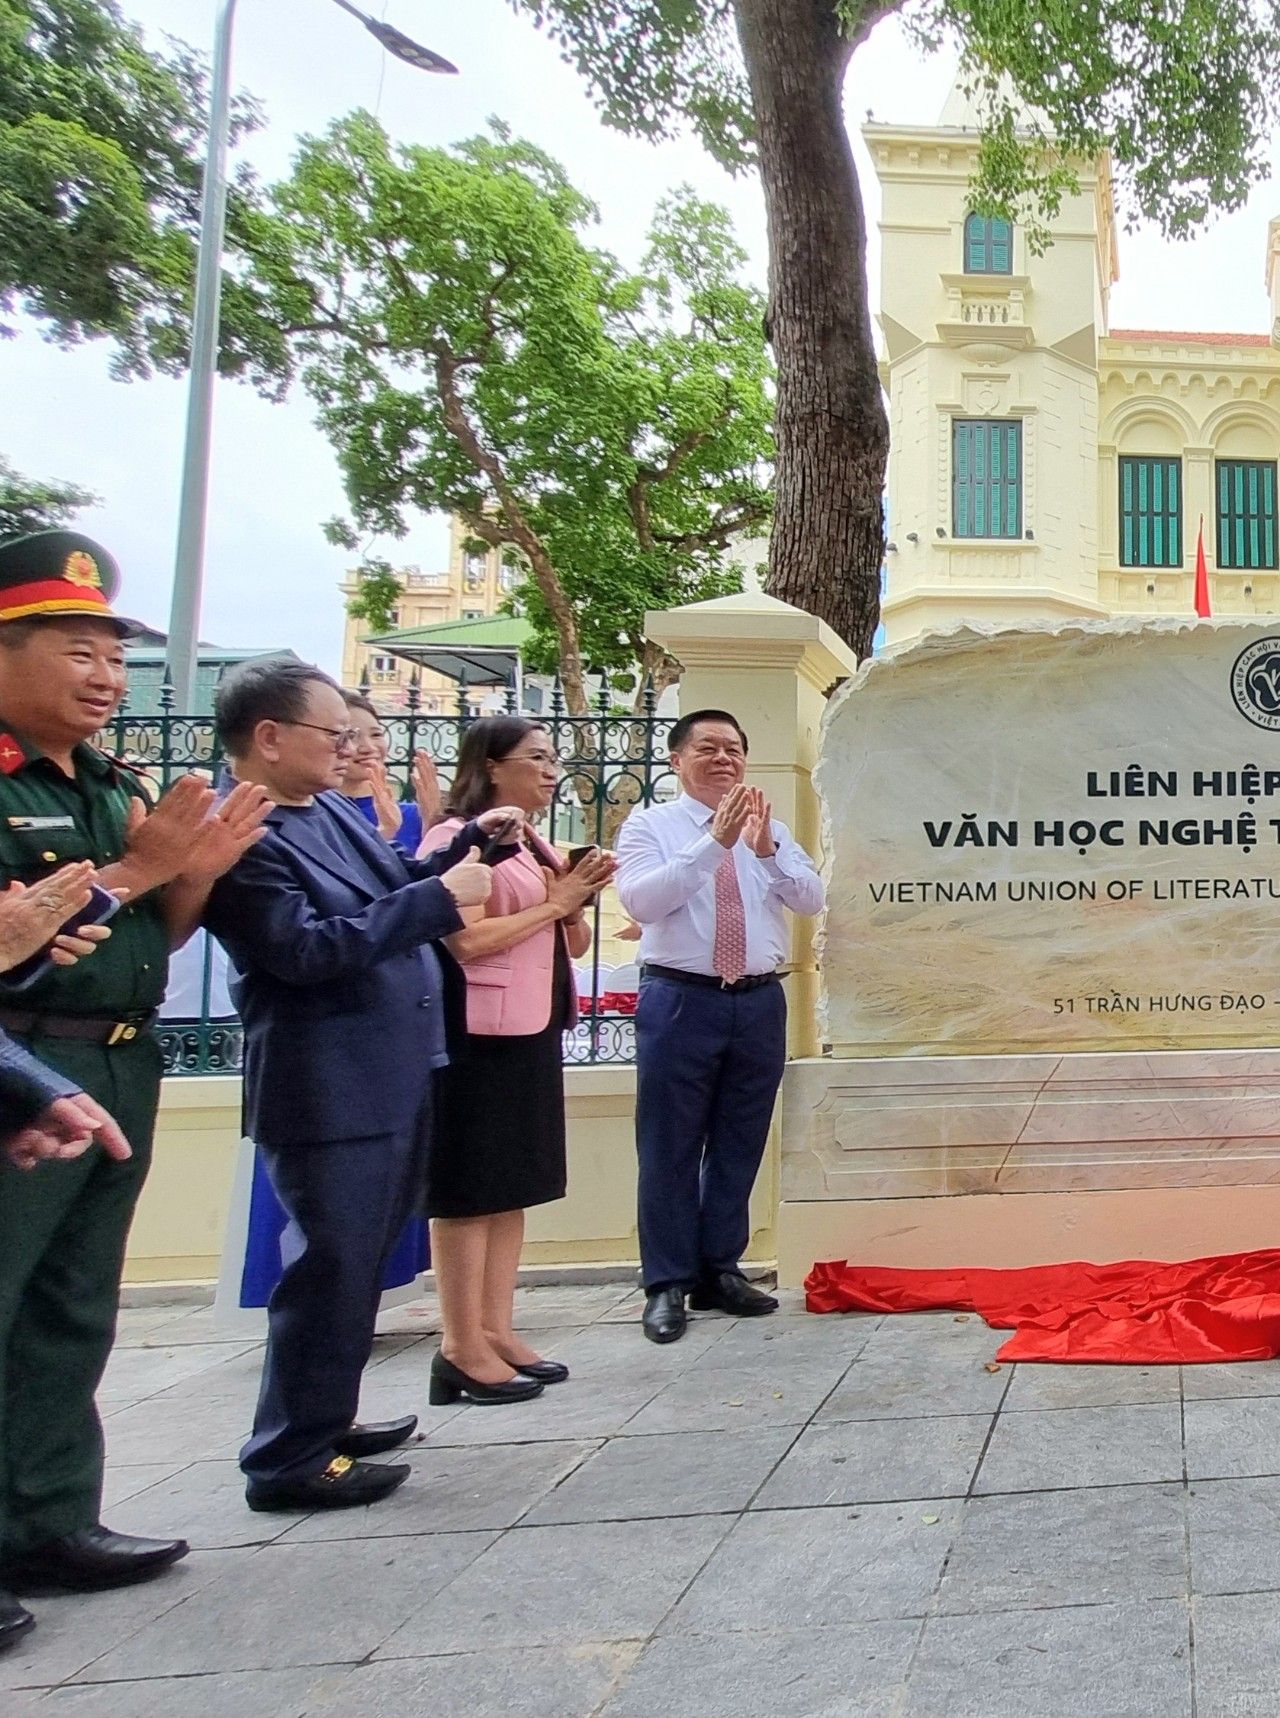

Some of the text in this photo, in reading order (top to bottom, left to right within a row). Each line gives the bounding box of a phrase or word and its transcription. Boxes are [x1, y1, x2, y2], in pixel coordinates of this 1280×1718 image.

[1235, 667, 1245, 687] HIỆP
[1243, 651, 1257, 665] CÁC
[1257, 642, 1271, 653] HỘI
[1257, 714, 1278, 727] VIỆT
[1087, 764, 1177, 797] LIÊN
[923, 813, 1018, 847] VĂN
[1034, 820, 1124, 855] HỌC
[1139, 812, 1257, 853] NGHỆ
[869, 882, 996, 903] VIETNAM
[1008, 881, 1095, 901] UNION
[1107, 880, 1143, 900] OF
[1054, 998, 1074, 1014] 51
[1085, 989, 1140, 1012] TRẦN
[1150, 993, 1212, 1012] HƯNG
[1220, 994, 1265, 1014] ĐẠO
